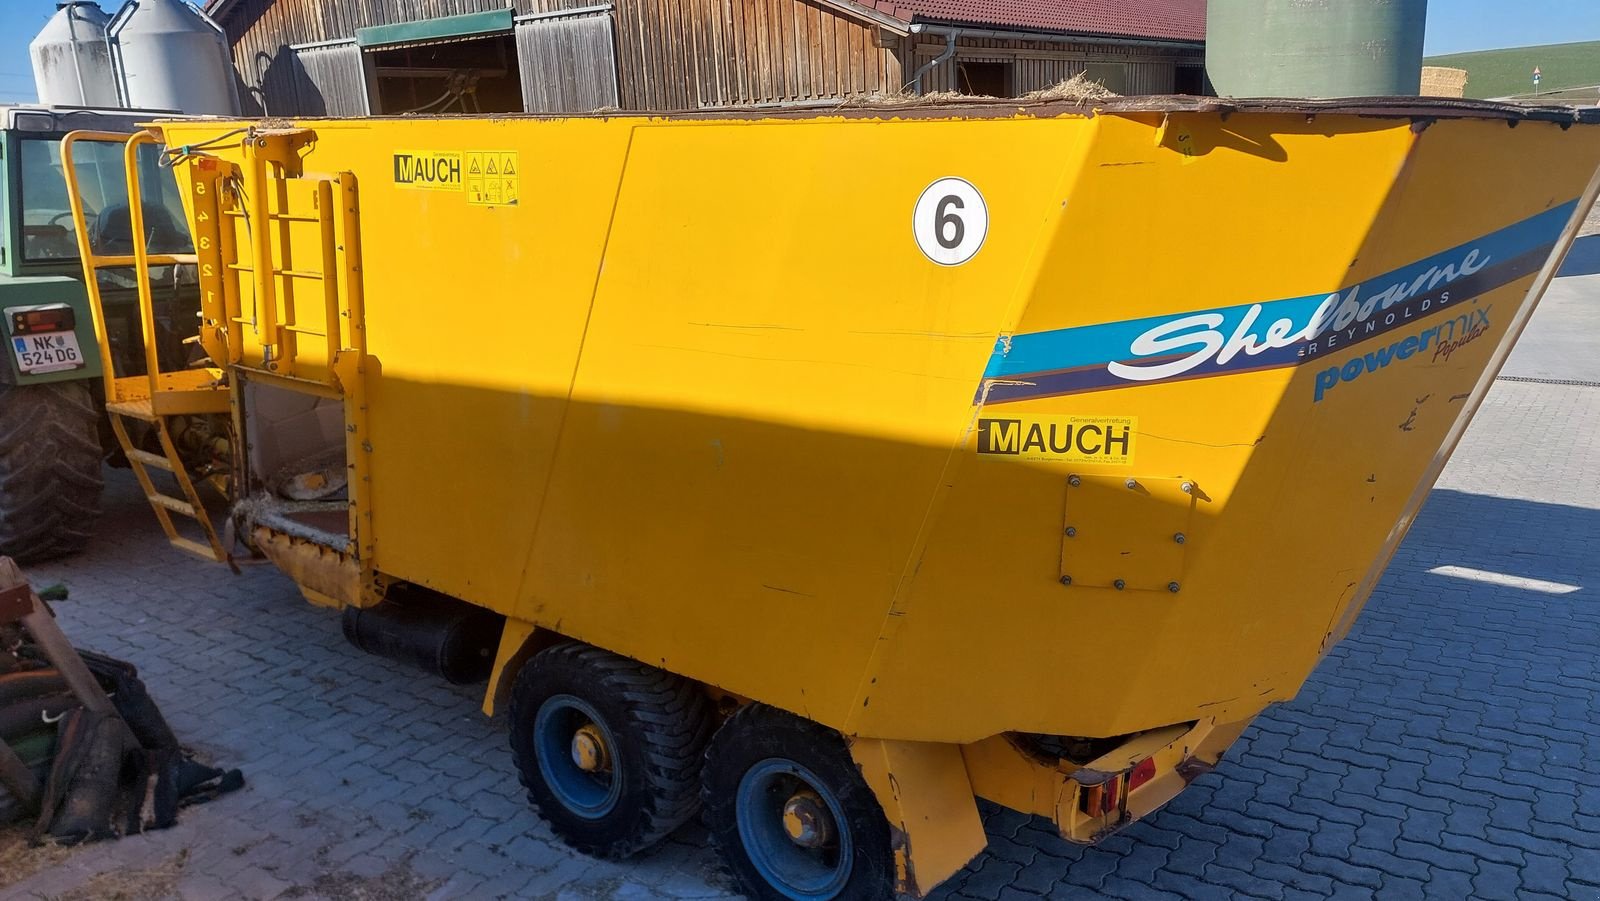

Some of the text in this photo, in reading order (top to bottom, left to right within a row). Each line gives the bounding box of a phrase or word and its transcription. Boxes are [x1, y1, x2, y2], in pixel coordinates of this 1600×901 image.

[394, 154, 461, 183] MAUCH
[934, 194, 965, 249] 6
[1108, 248, 1491, 381] Shelbourne
[1308, 292, 1450, 355] REYNOLDS
[22, 348, 77, 367] 524 DG
[33, 336, 55, 351] NK
[1432, 322, 1490, 363] Popular
[977, 419, 1130, 456] MAUCH
[1069, 416, 1132, 425] Generalvertretung
